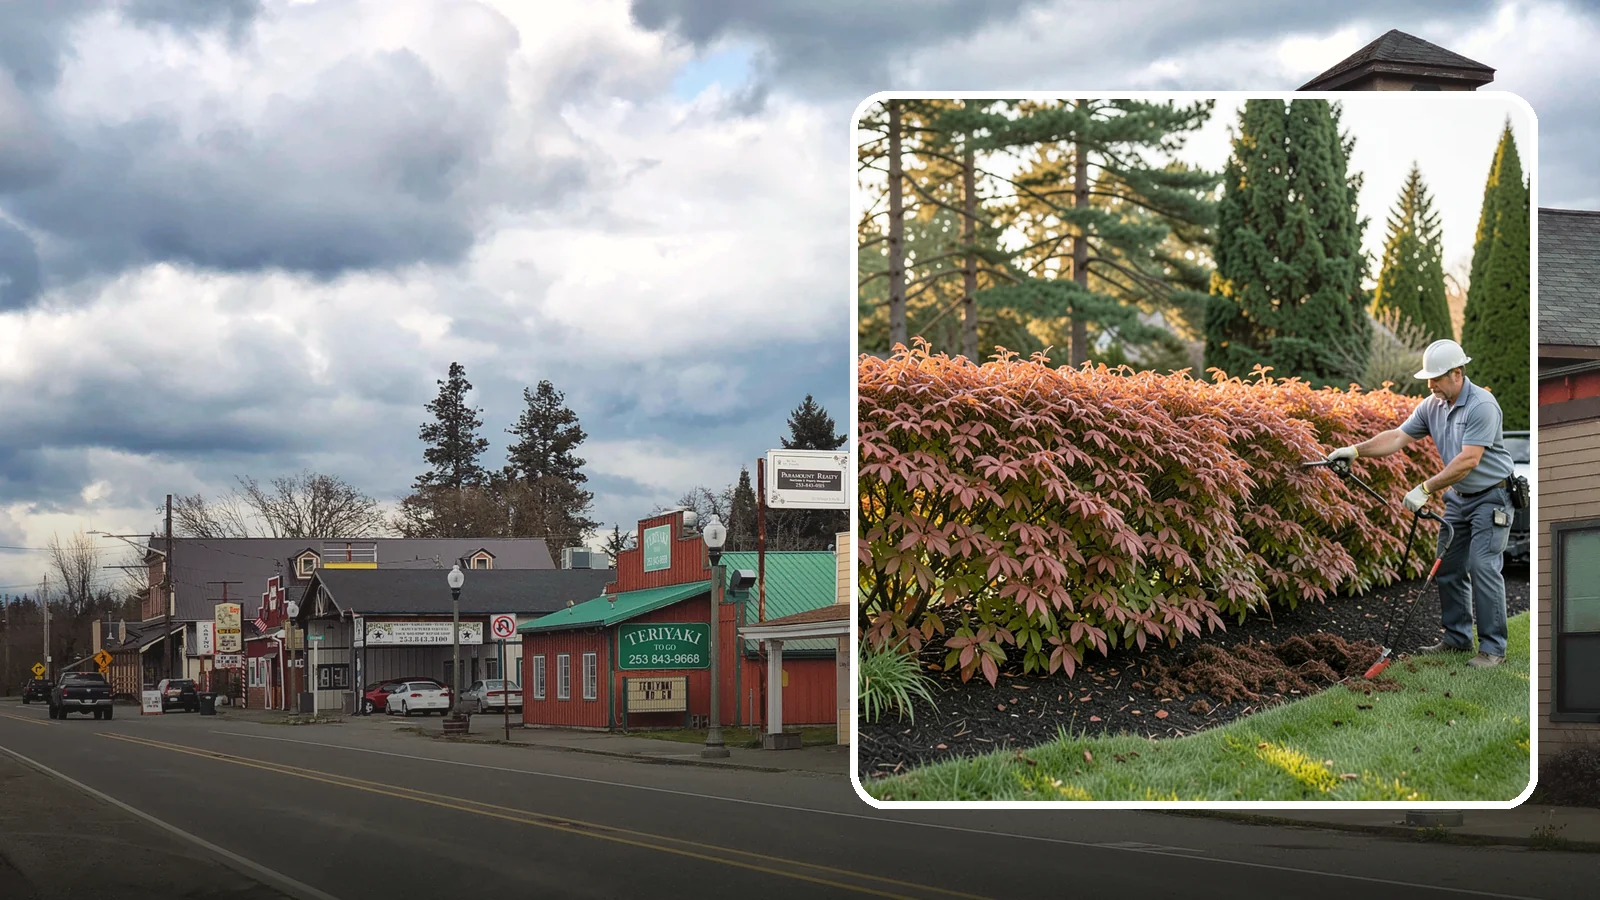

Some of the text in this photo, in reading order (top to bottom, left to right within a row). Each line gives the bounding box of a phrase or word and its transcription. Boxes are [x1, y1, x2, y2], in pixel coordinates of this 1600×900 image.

[646, 530, 669, 549] TERIYAKI
[624, 627, 702, 646] TERIYAKI
[653, 643, 677, 651] TO GO
[628, 653, 700, 664] 253 843-9668
